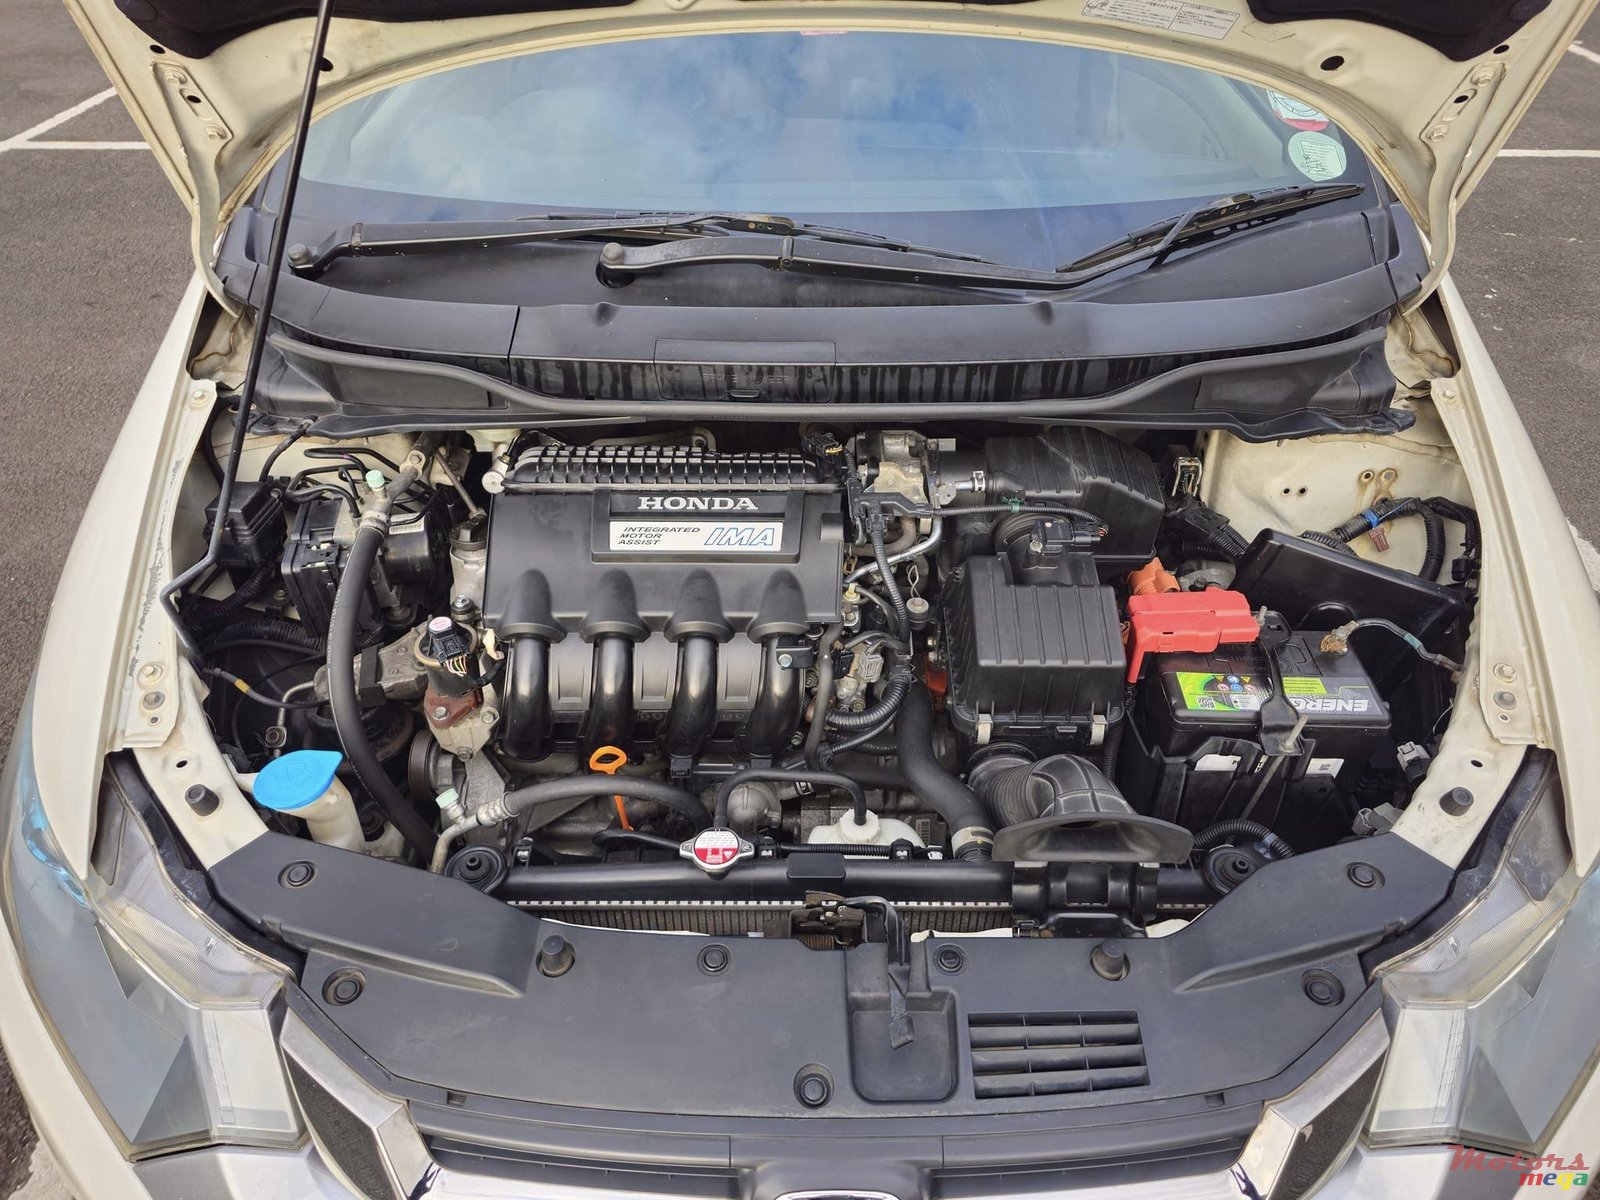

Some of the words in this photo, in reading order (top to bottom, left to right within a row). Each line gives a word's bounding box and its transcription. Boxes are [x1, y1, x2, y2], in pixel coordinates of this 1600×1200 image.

[637, 496, 759, 511] HONDA
[703, 527, 776, 547] IMA
[1289, 698, 1369, 712] ENERG
